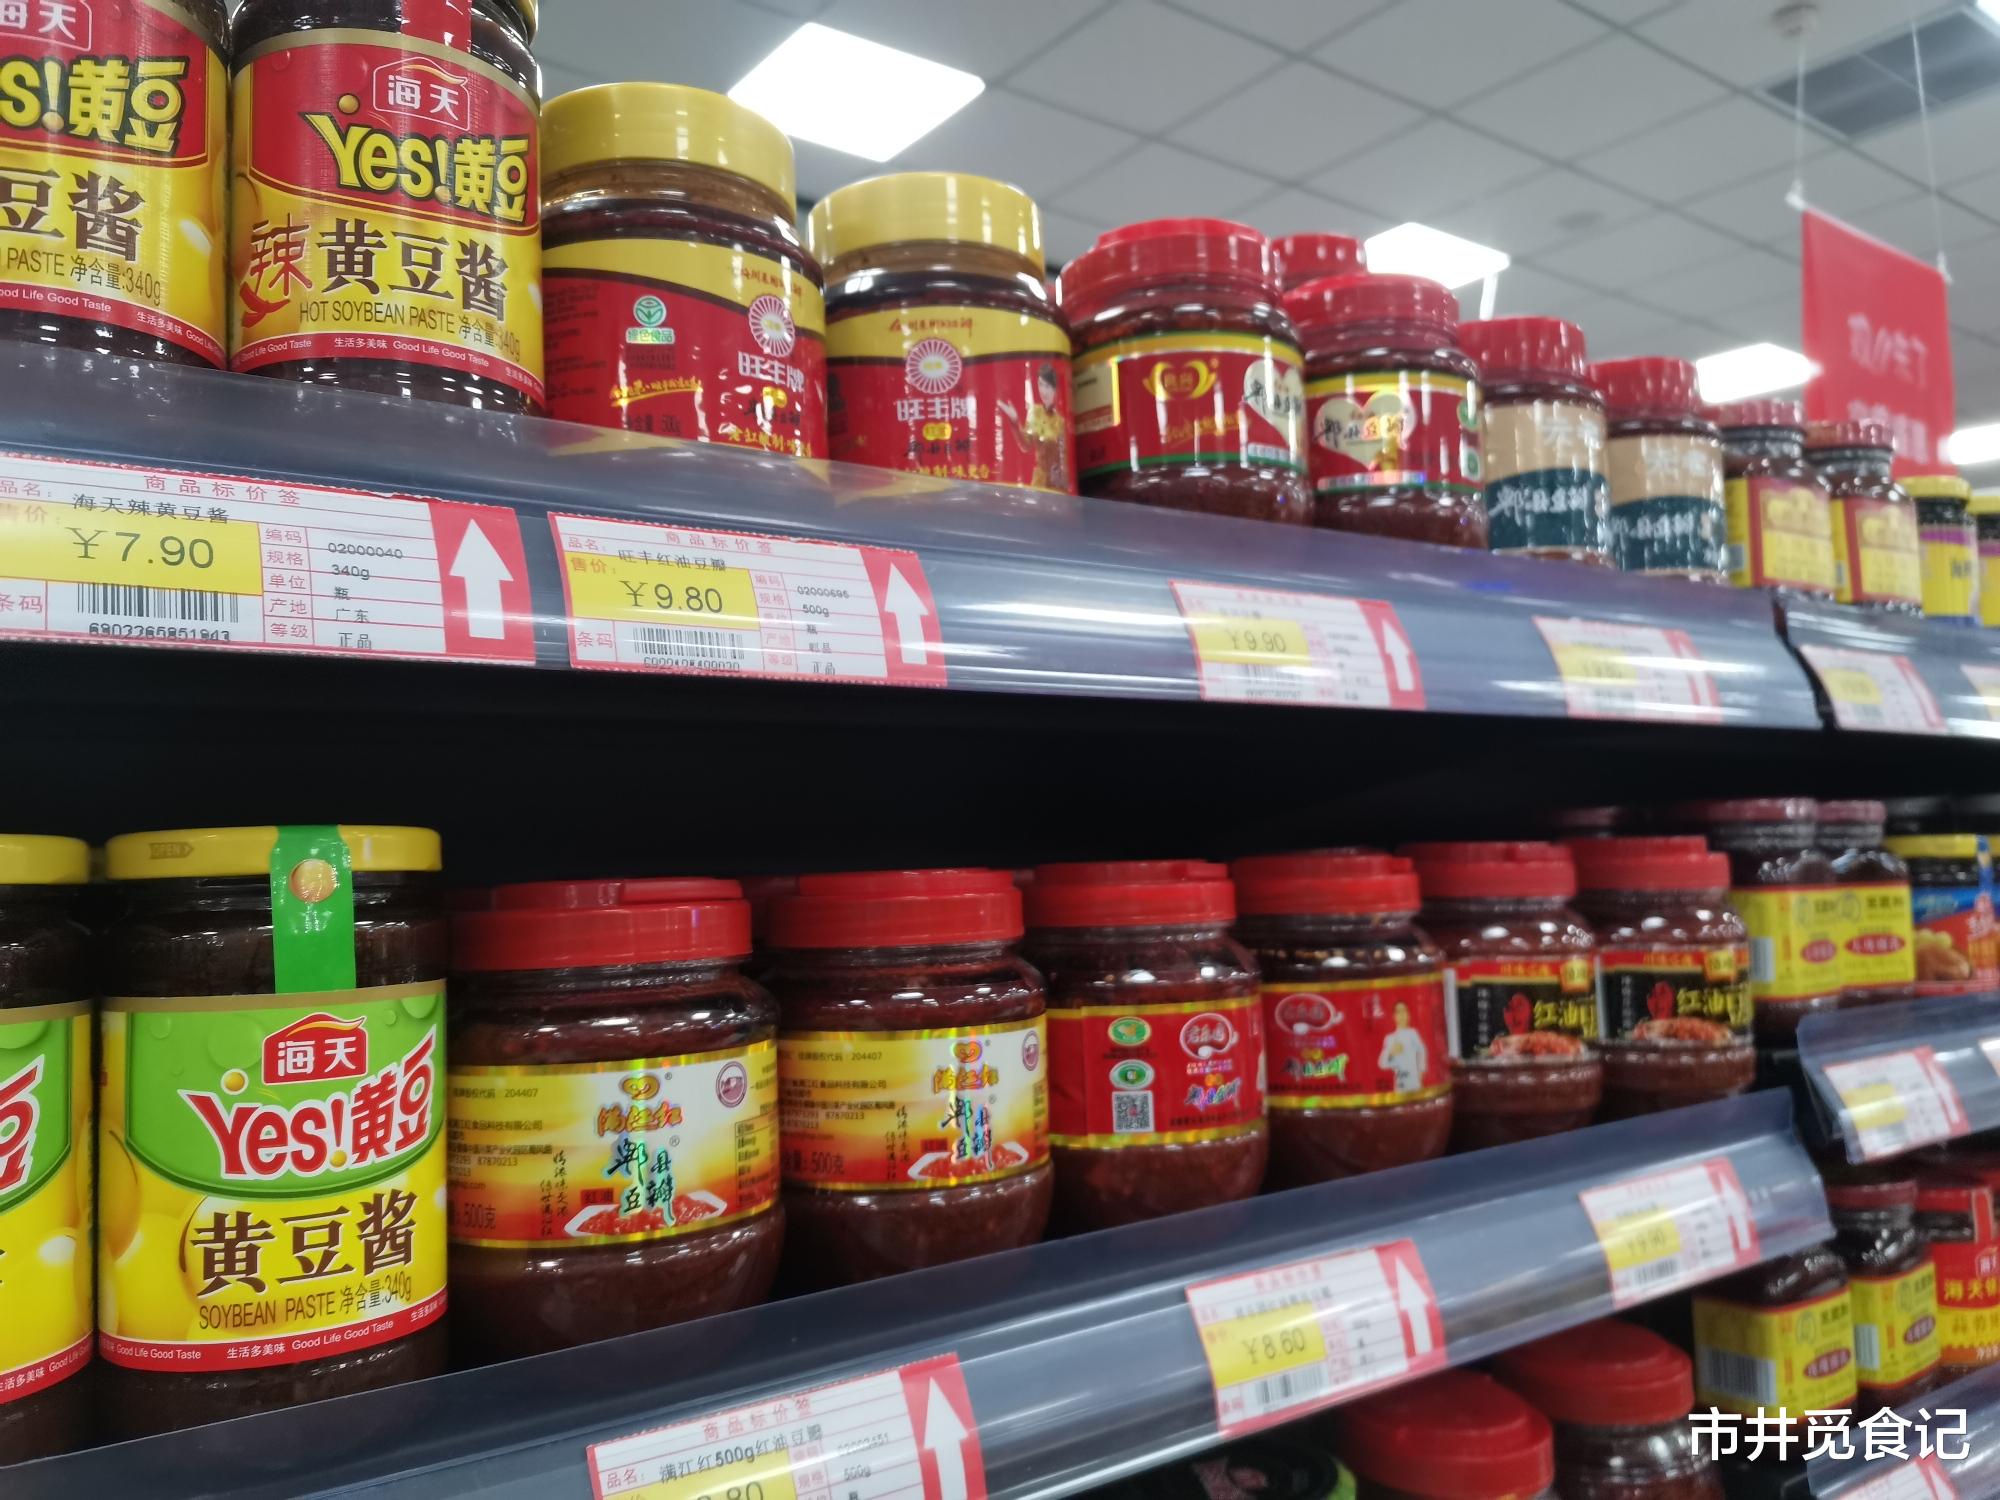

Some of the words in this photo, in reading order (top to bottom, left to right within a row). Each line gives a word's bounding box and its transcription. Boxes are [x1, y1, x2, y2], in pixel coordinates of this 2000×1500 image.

[387, 74, 460, 121] 海天
[7, 247, 65, 276] PASTE
[23, 289, 44, 300] Life
[47, 293, 79, 306] Good
[82, 298, 112, 312] Taste
[301, 302, 327, 322] HOT
[332, 301, 404, 325] SOYBEAN
[410, 306, 455, 334] PASTE
[267, 341, 288, 353] Good
[290, 339, 312, 349] Taste
[334, 338, 388, 349] 生活多美味
[393, 341, 419, 352] Good
[422, 345, 439, 355] Life
[442, 348, 466, 361] Good
[468, 353, 489, 367] Taste
[144, 475, 301, 506] 商品标价签
[73, 493, 229, 524] 海天辣黄豆酱
[266, 529, 302, 544] 编码
[665, 531, 772, 554] 商品标价签
[65, 527, 215, 570] ¥7.90
[267, 551, 303, 566] 规格
[328, 542, 403, 560] 02000040
[331, 564, 370, 580] 340g
[269, 575, 306, 590] 单位
[333, 586, 349, 601] 瓶
[619, 580, 723, 613] ¥9.80
[270, 598, 307, 615] 产地
[335, 608, 370, 623] 广东
[802, 604, 830, 618] 500g
[271, 624, 308, 639] 等级
[338, 632, 372, 650] 正品
[577, 631, 614, 649] 条码
[278, 1036, 357, 1077] 海天
[190, 1189, 420, 1297] 黄豆酱
[199, 1302, 277, 1330] SOYBEAN
[285, 1291, 335, 1322] PASTE
[227, 1343, 286, 1359] 生活多美味
[291, 1336, 321, 1351] Good
[323, 1330, 341, 1344] Life
[344, 1327, 369, 1341] Good
[371, 1319, 394, 1333] Taste
[134, 1345, 148, 1358] Life
[150, 1347, 173, 1360] Good
[176, 1348, 201, 1360] Taste
